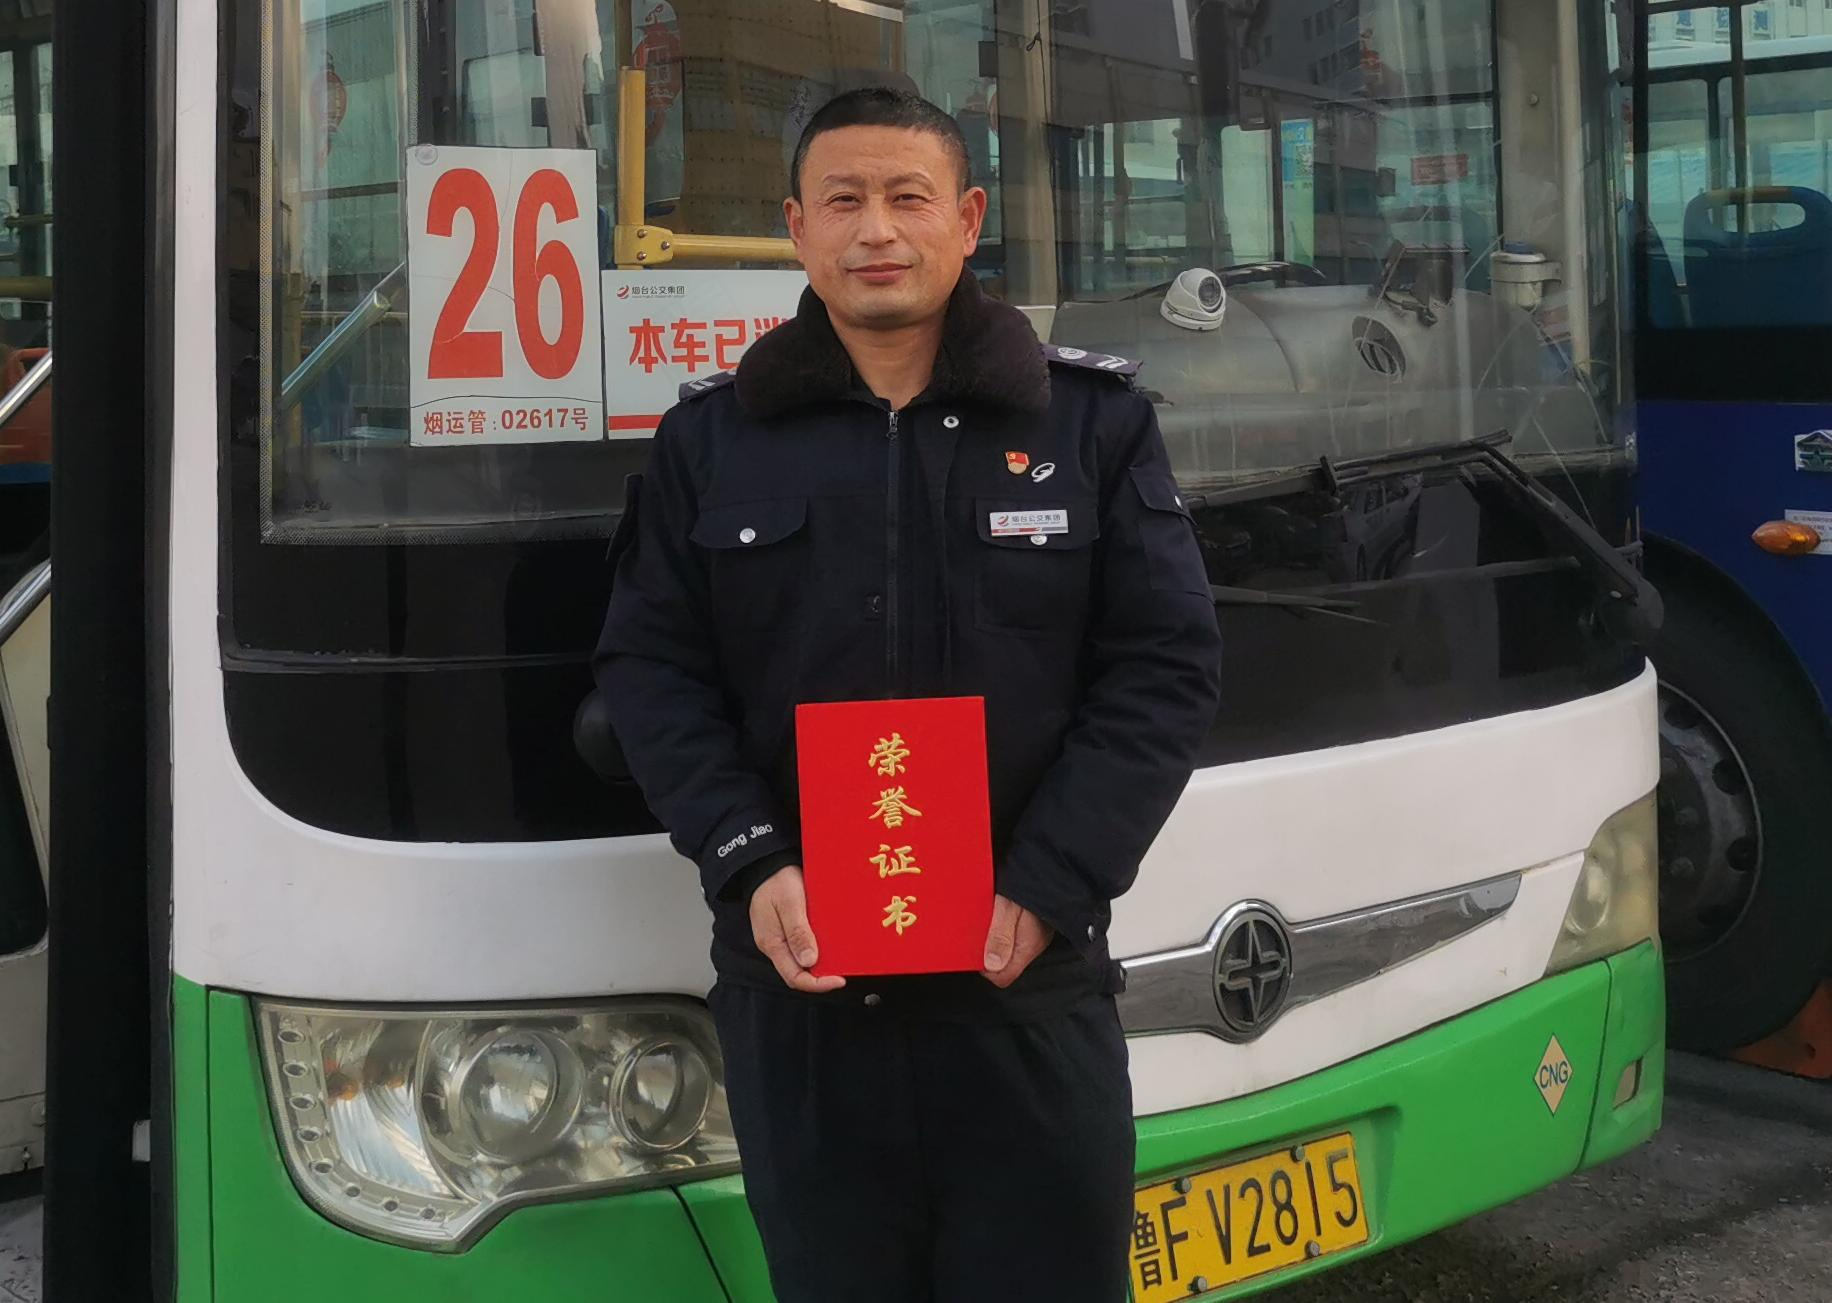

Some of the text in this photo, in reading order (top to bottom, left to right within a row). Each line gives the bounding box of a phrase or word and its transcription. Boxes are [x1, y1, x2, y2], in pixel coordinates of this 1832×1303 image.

[426, 168, 584, 379] 26
[631, 285, 685, 295] 烟台公交集团
[629, 317, 787, 373] 本车已
[717, 823, 774, 857] Gong Jiao
[868, 733, 923, 935] 荣誉证书
[1540, 1061, 1569, 1089] CNG
